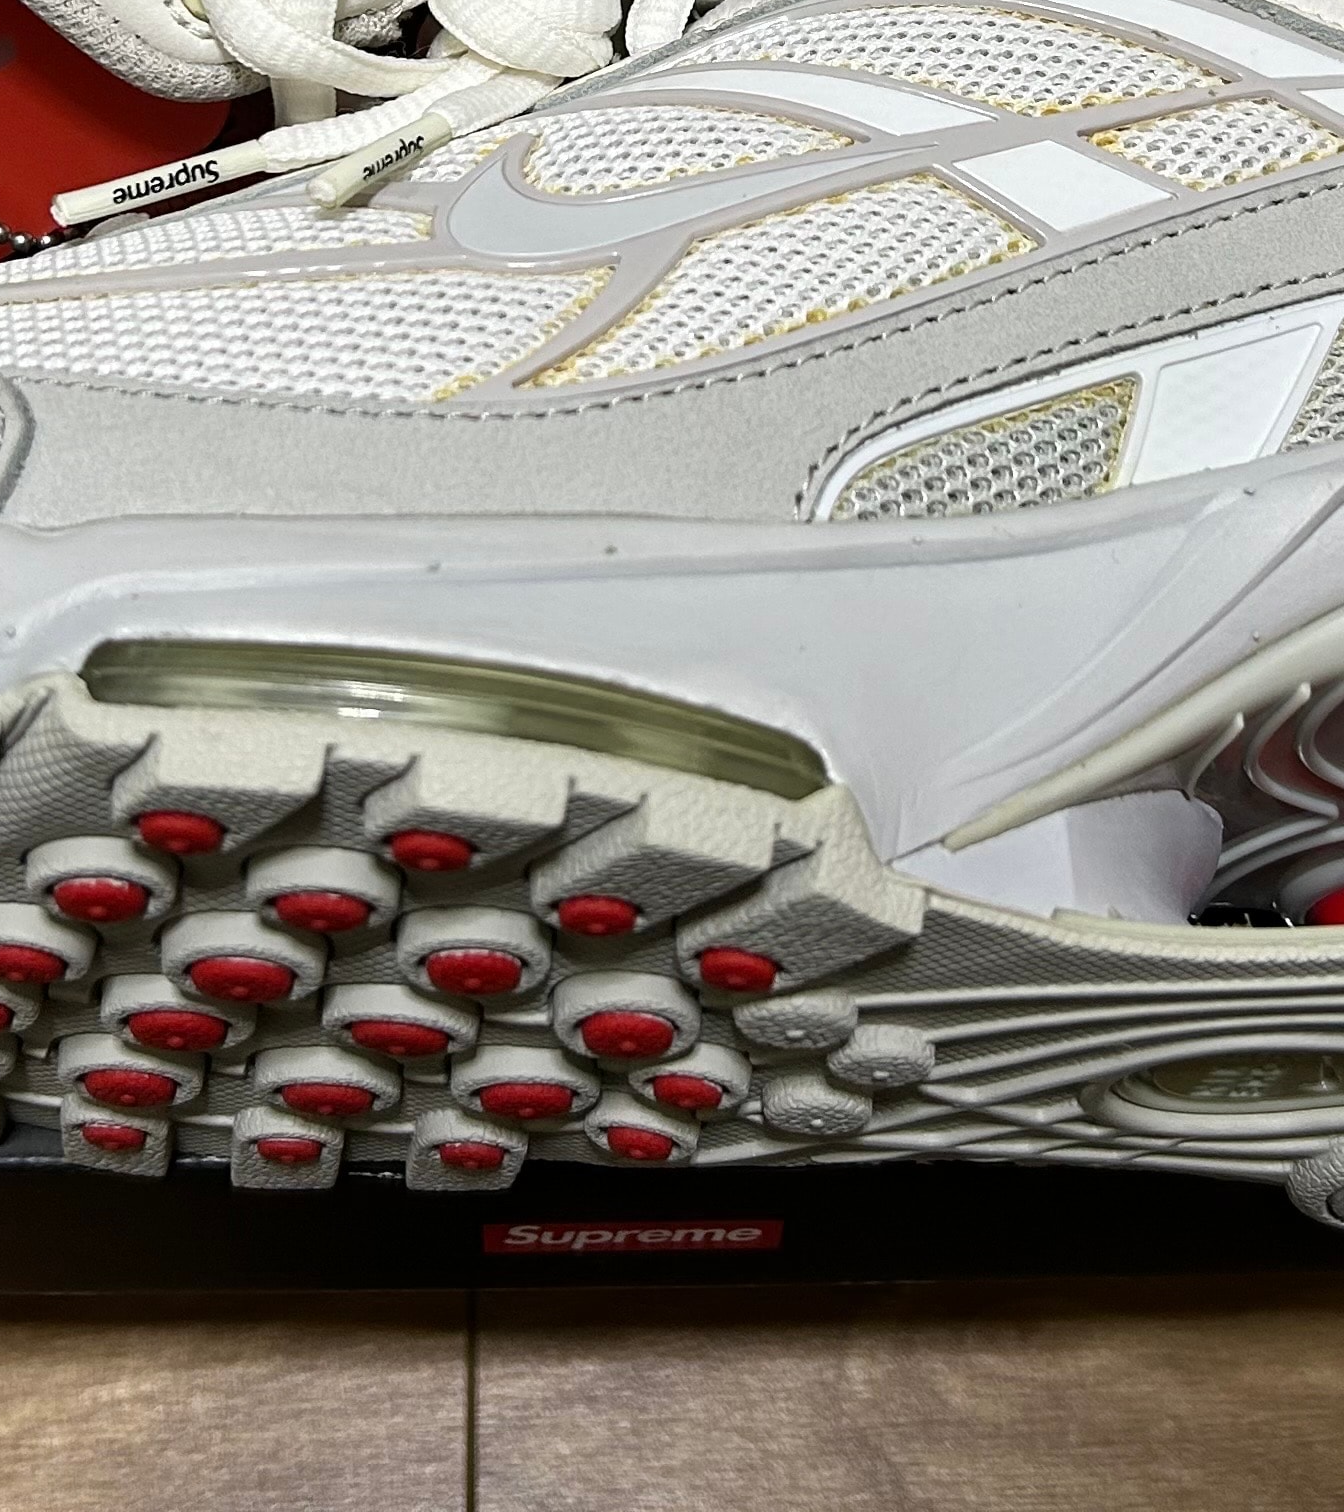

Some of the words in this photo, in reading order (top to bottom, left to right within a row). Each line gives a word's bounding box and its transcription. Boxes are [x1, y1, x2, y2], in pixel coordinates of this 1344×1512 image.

[362, 134, 425, 180] Supreme
[112, 159, 221, 204] Supreme
[505, 1224, 763, 1251] Supreme
